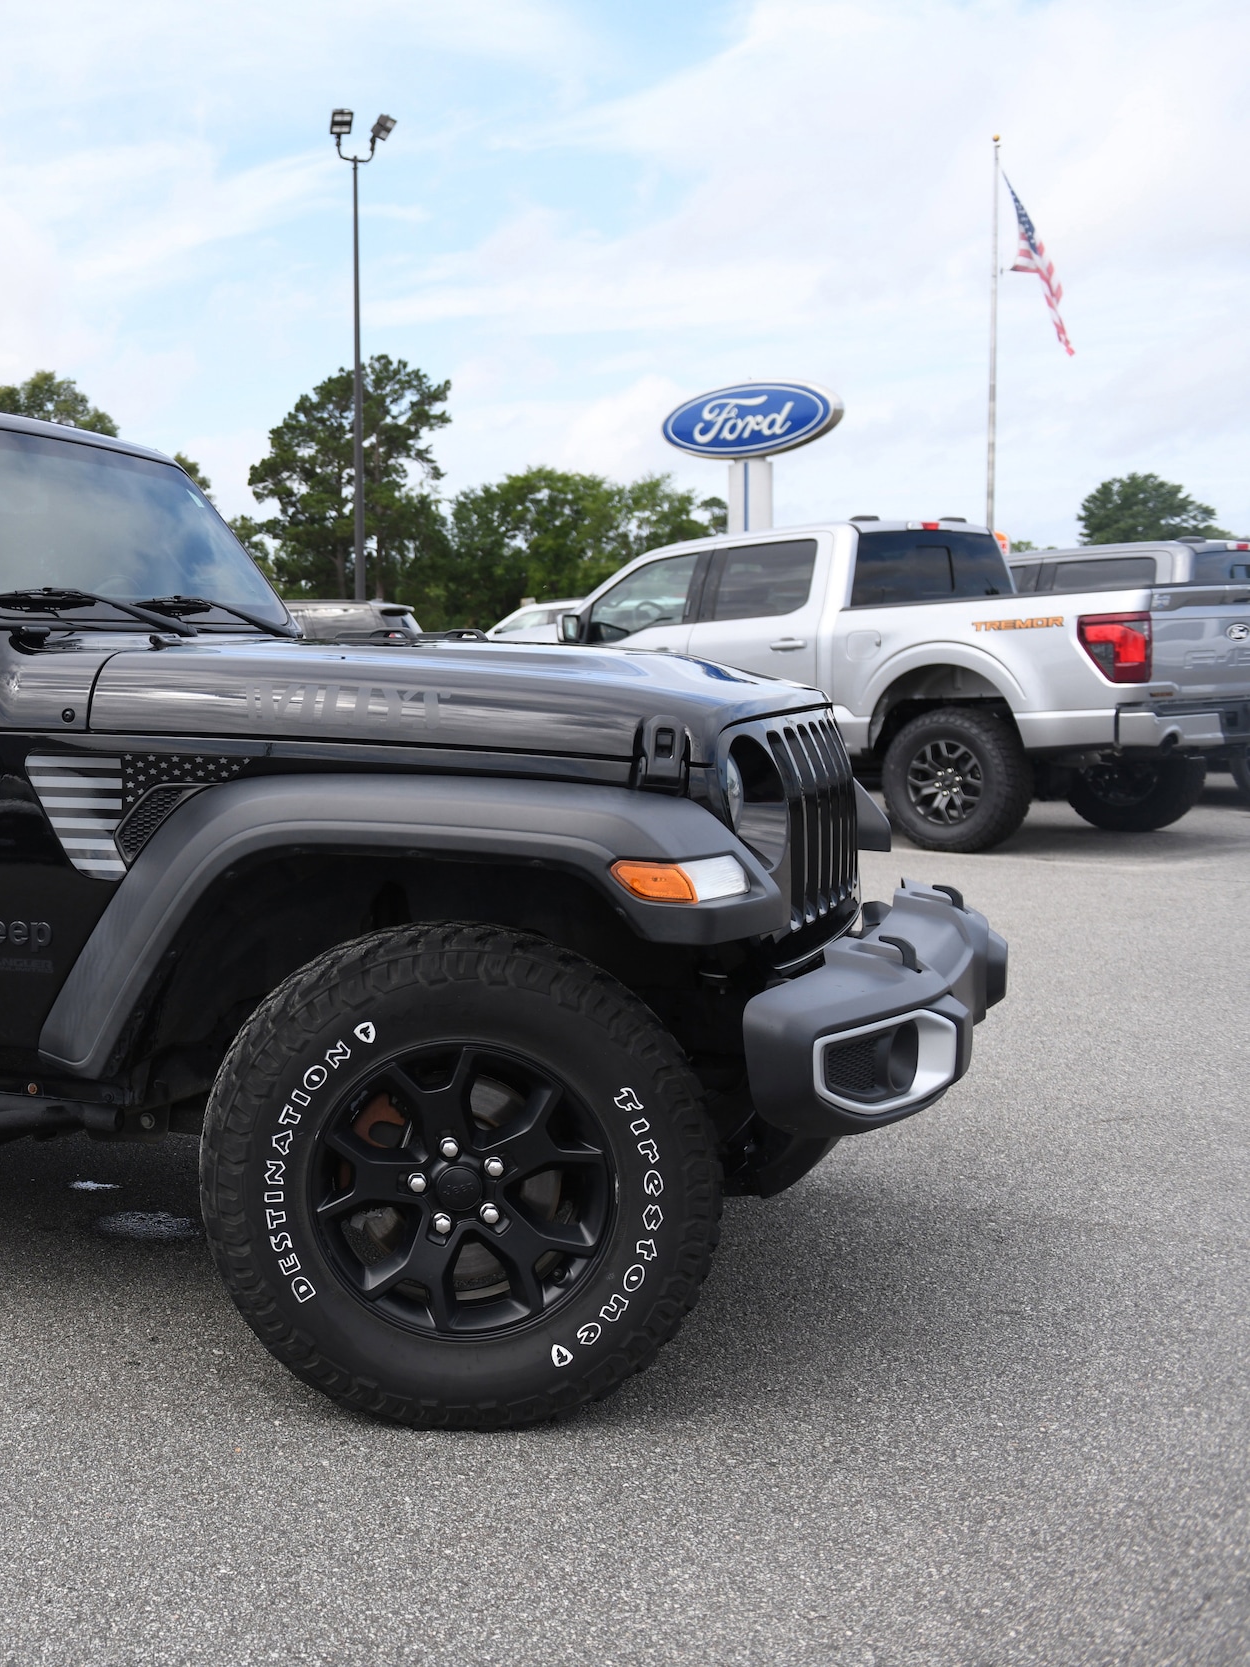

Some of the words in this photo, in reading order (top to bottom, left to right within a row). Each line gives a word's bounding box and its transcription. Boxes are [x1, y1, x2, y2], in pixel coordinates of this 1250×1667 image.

[693, 395, 795, 444] Ford
[972, 616, 1064, 632] TREMOR
[264, 1041, 352, 1303] DESTINATION
[577, 1087, 664, 1346] Firestone
